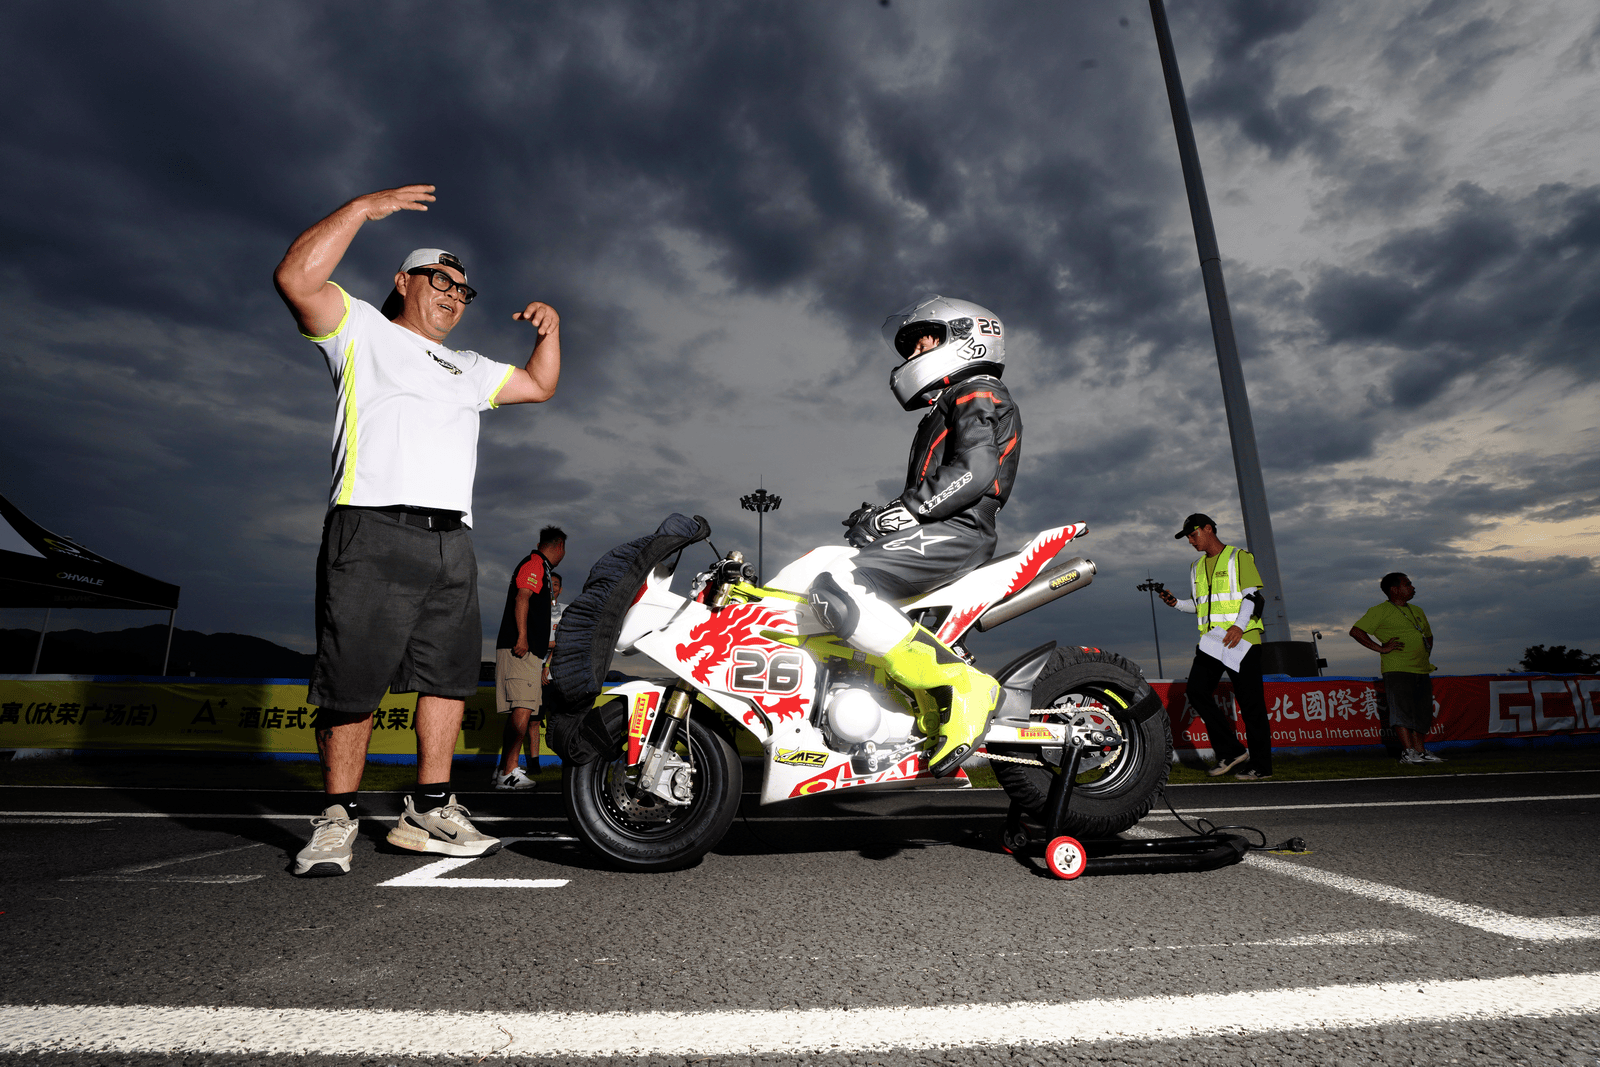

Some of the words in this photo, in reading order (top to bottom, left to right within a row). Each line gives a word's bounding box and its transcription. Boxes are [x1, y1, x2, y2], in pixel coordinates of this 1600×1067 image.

[977, 318, 1002, 336] 26
[919, 472, 973, 514] alpinestars
[56, 572, 104, 586] OHVALE
[1051, 570, 1077, 588] ARROW
[732, 650, 802, 693] 26
[630, 696, 647, 735] PIRELLI
[1326, 726, 1397, 740] Internation
[789, 752, 827, 763] MFZ
[799, 758, 929, 795] OHVAL
